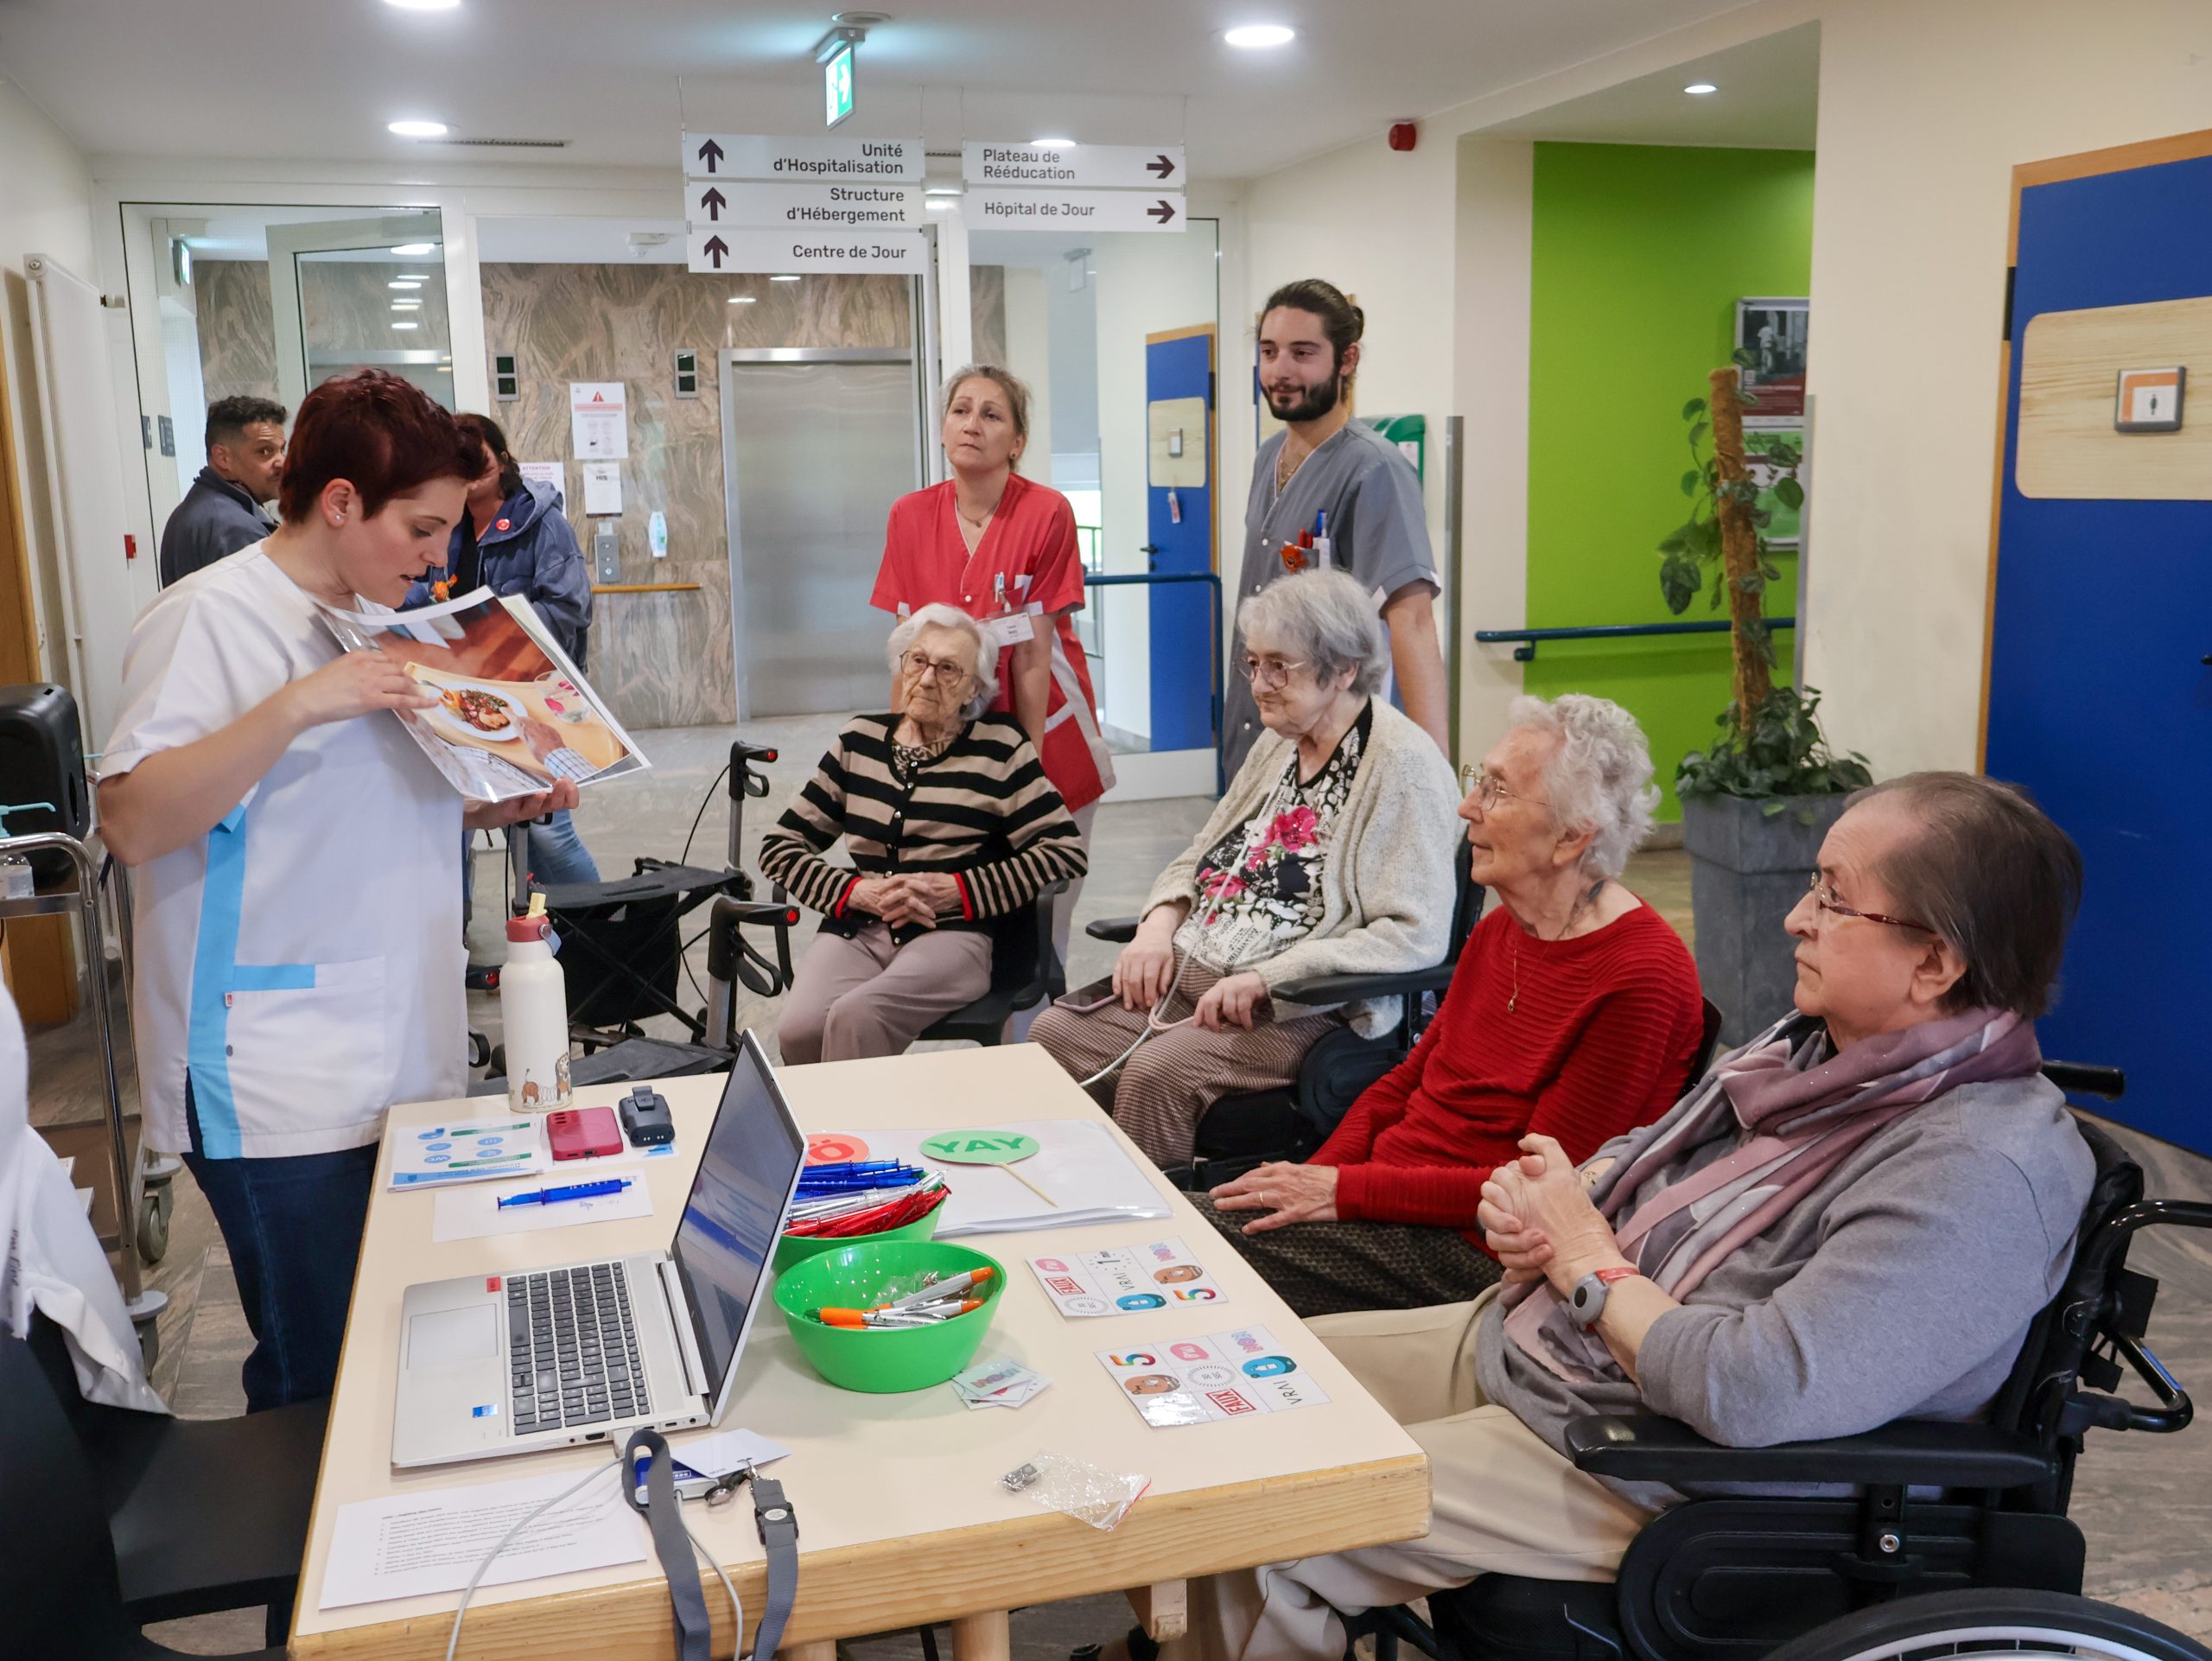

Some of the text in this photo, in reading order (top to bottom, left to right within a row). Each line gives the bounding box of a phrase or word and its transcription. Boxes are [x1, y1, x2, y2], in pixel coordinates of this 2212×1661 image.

[861, 143, 903, 157] Unité
[982, 149, 1060, 163] Plateau de
[773, 158, 904, 175] d'Hospitalisation
[983, 164, 1076, 180] Rééducation
[830, 187, 905, 202] Structure
[786, 206, 906, 225] d'Hébergement
[984, 201, 1096, 218] Hôpital de Jour
[792, 245, 907, 259] Centre de Jour
[927, 1137, 1025, 1153] YAY
[1050, 1278, 1079, 1294] FAUX
[1112, 1272, 1135, 1291] VRAI
[1231, 1331, 1263, 1353] NON
[1274, 1380, 1302, 1405] VRAI
[1211, 1391, 1250, 1413] FAUX
